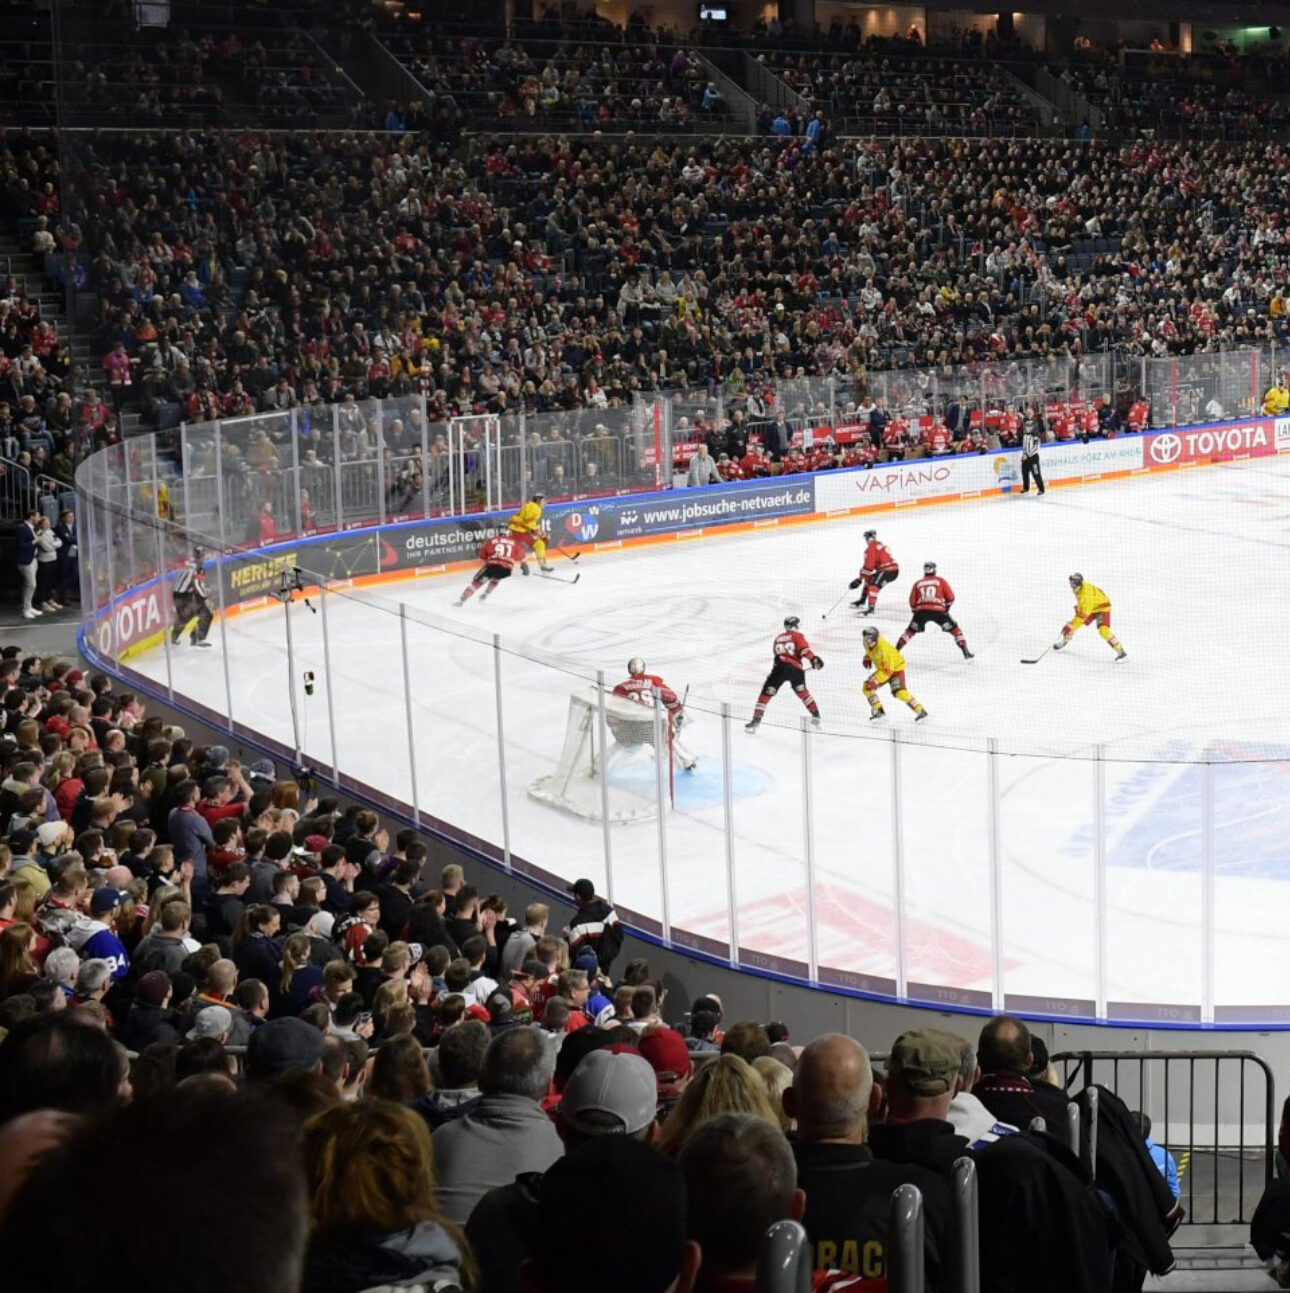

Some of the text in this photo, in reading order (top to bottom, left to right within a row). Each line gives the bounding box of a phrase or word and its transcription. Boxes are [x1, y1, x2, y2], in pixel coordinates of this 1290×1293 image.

[1186, 426, 1267, 456] TOYOTA
[856, 467, 950, 493] VAPIANO
[643, 490, 811, 524] www.jobsuche-netvaerk.de
[495, 544, 511, 557] 91
